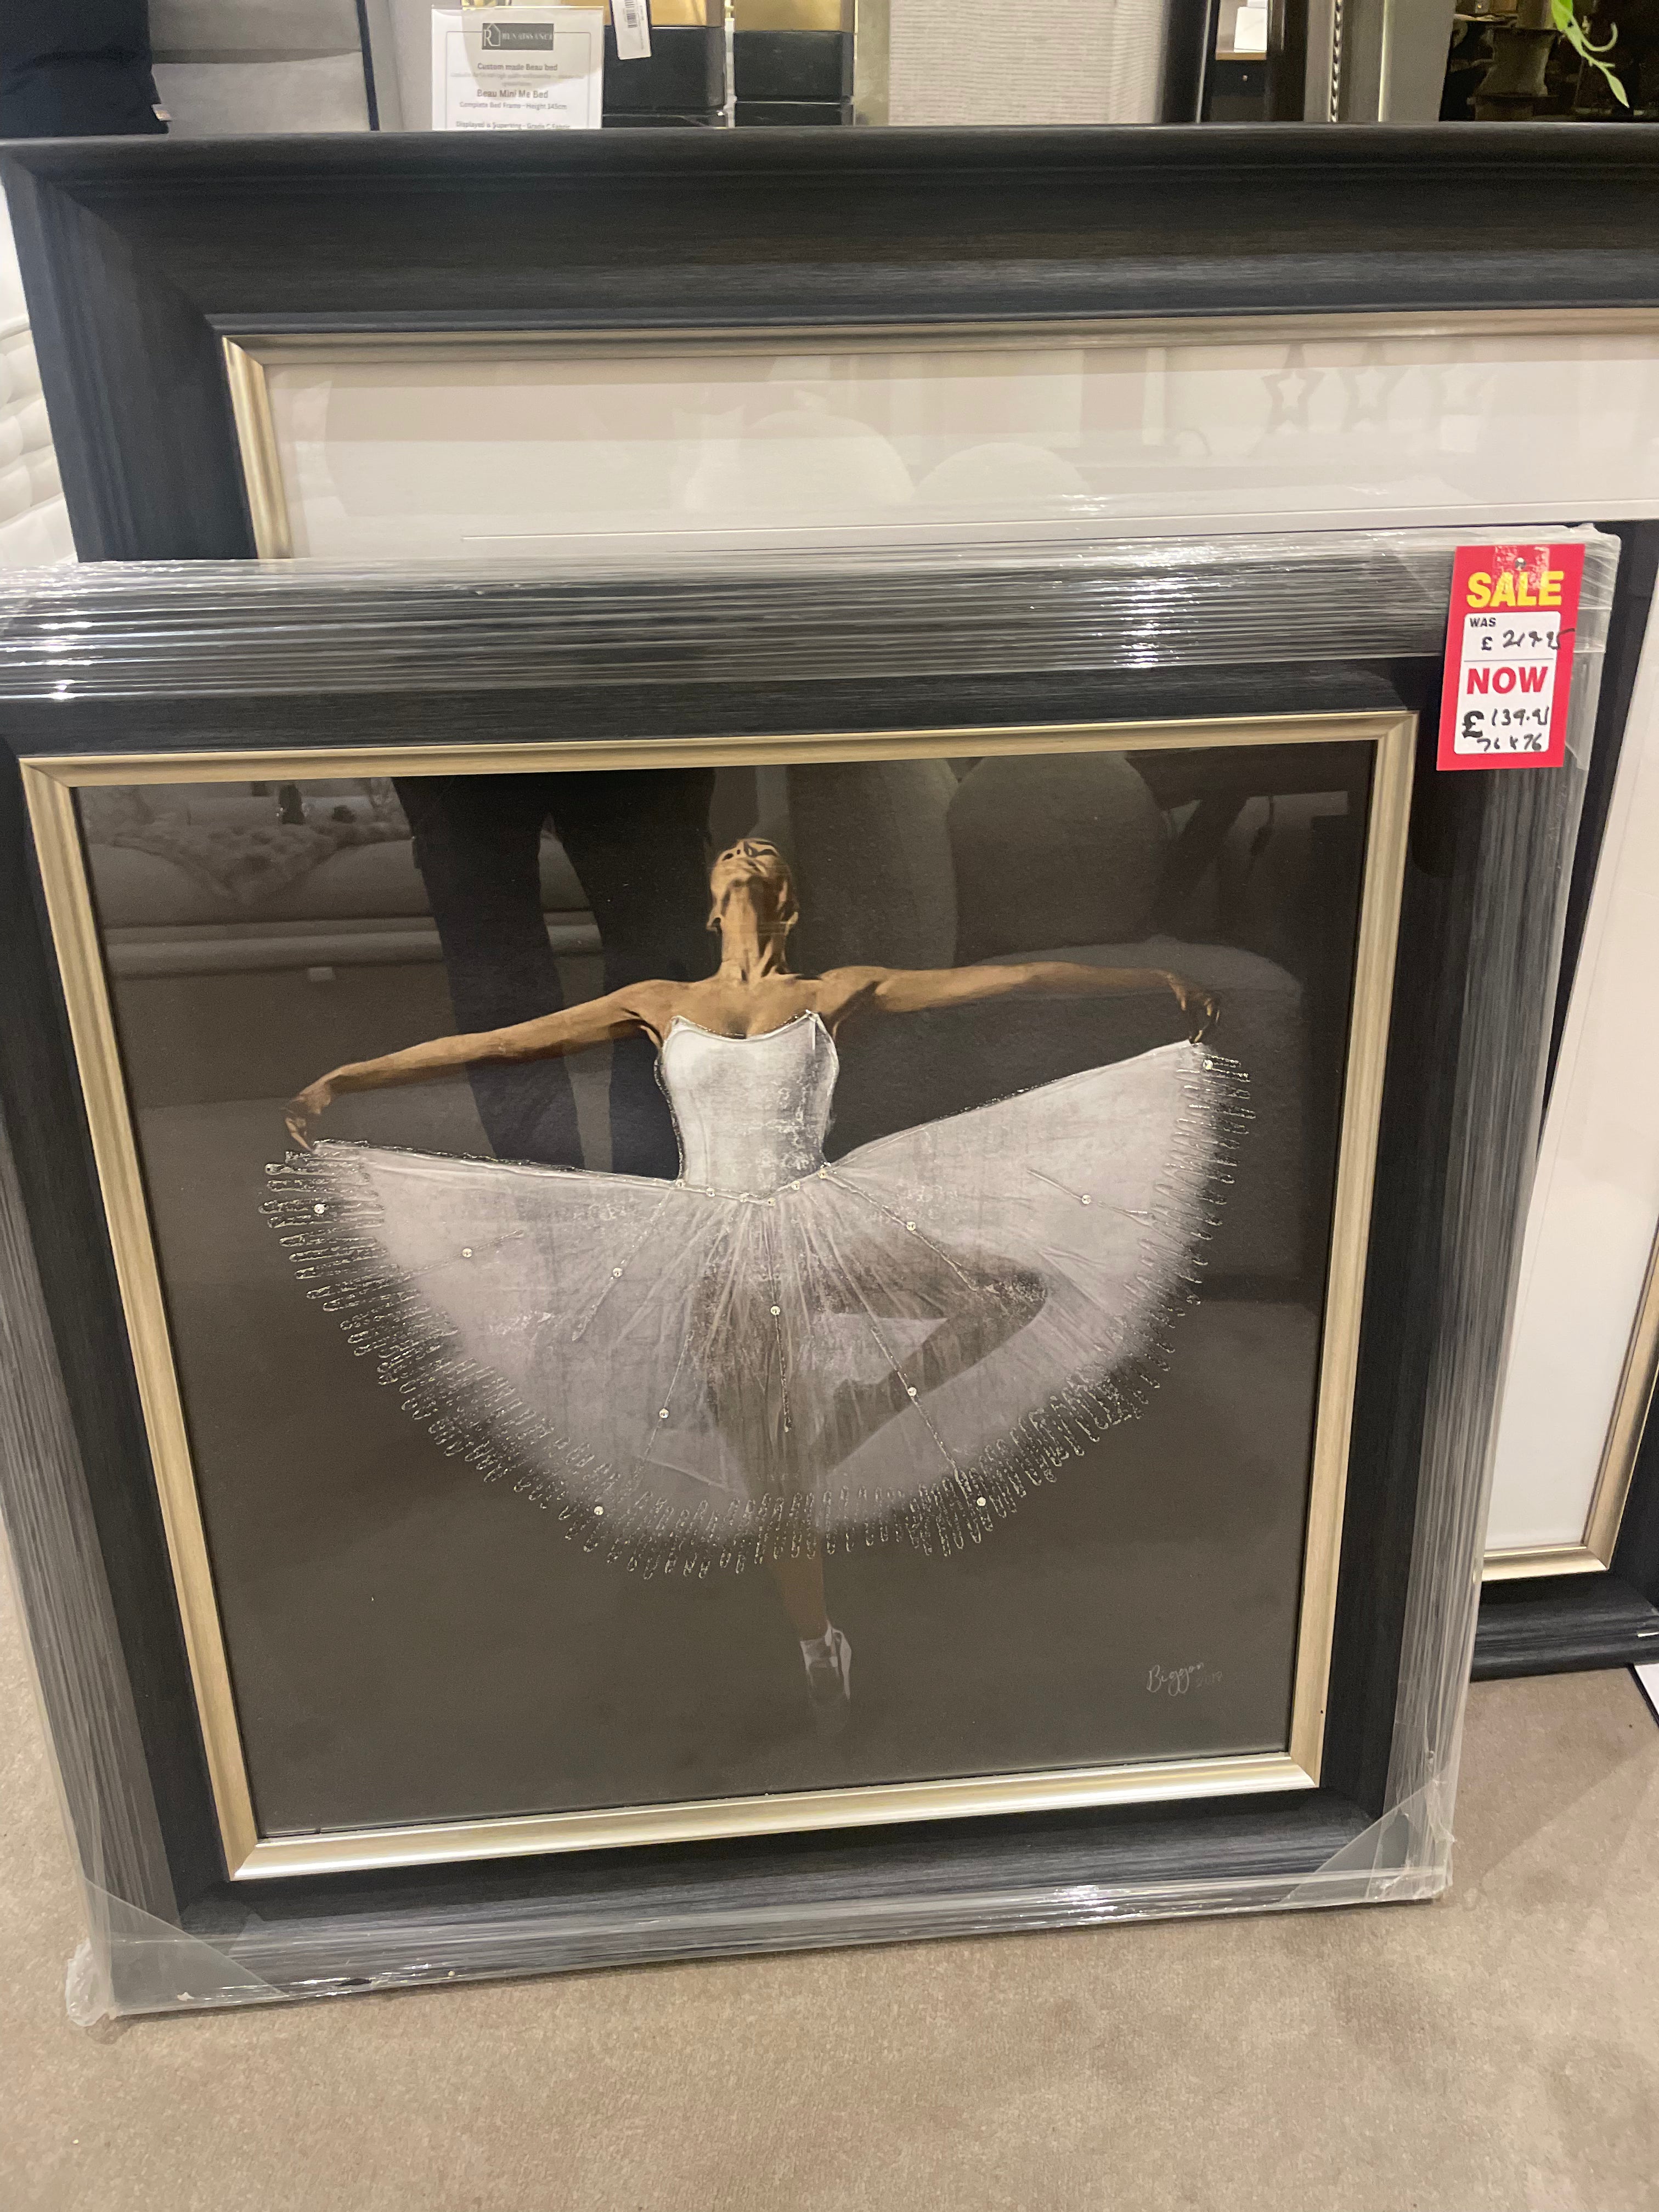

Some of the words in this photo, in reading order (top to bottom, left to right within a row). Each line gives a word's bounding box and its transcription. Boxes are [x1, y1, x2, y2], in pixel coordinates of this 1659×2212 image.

[477, 63, 504, 71] Custom
[477, 89, 497, 98] Beau
[500, 89, 517, 98] Mini
[533, 90, 549, 99] Bed
[1466, 571, 1564, 607] SALE
[1470, 617, 1496, 627] WAS
[1481, 636, 1493, 650] £
[1467, 667, 1548, 694] NOW
[1462, 710, 1485, 738] £
